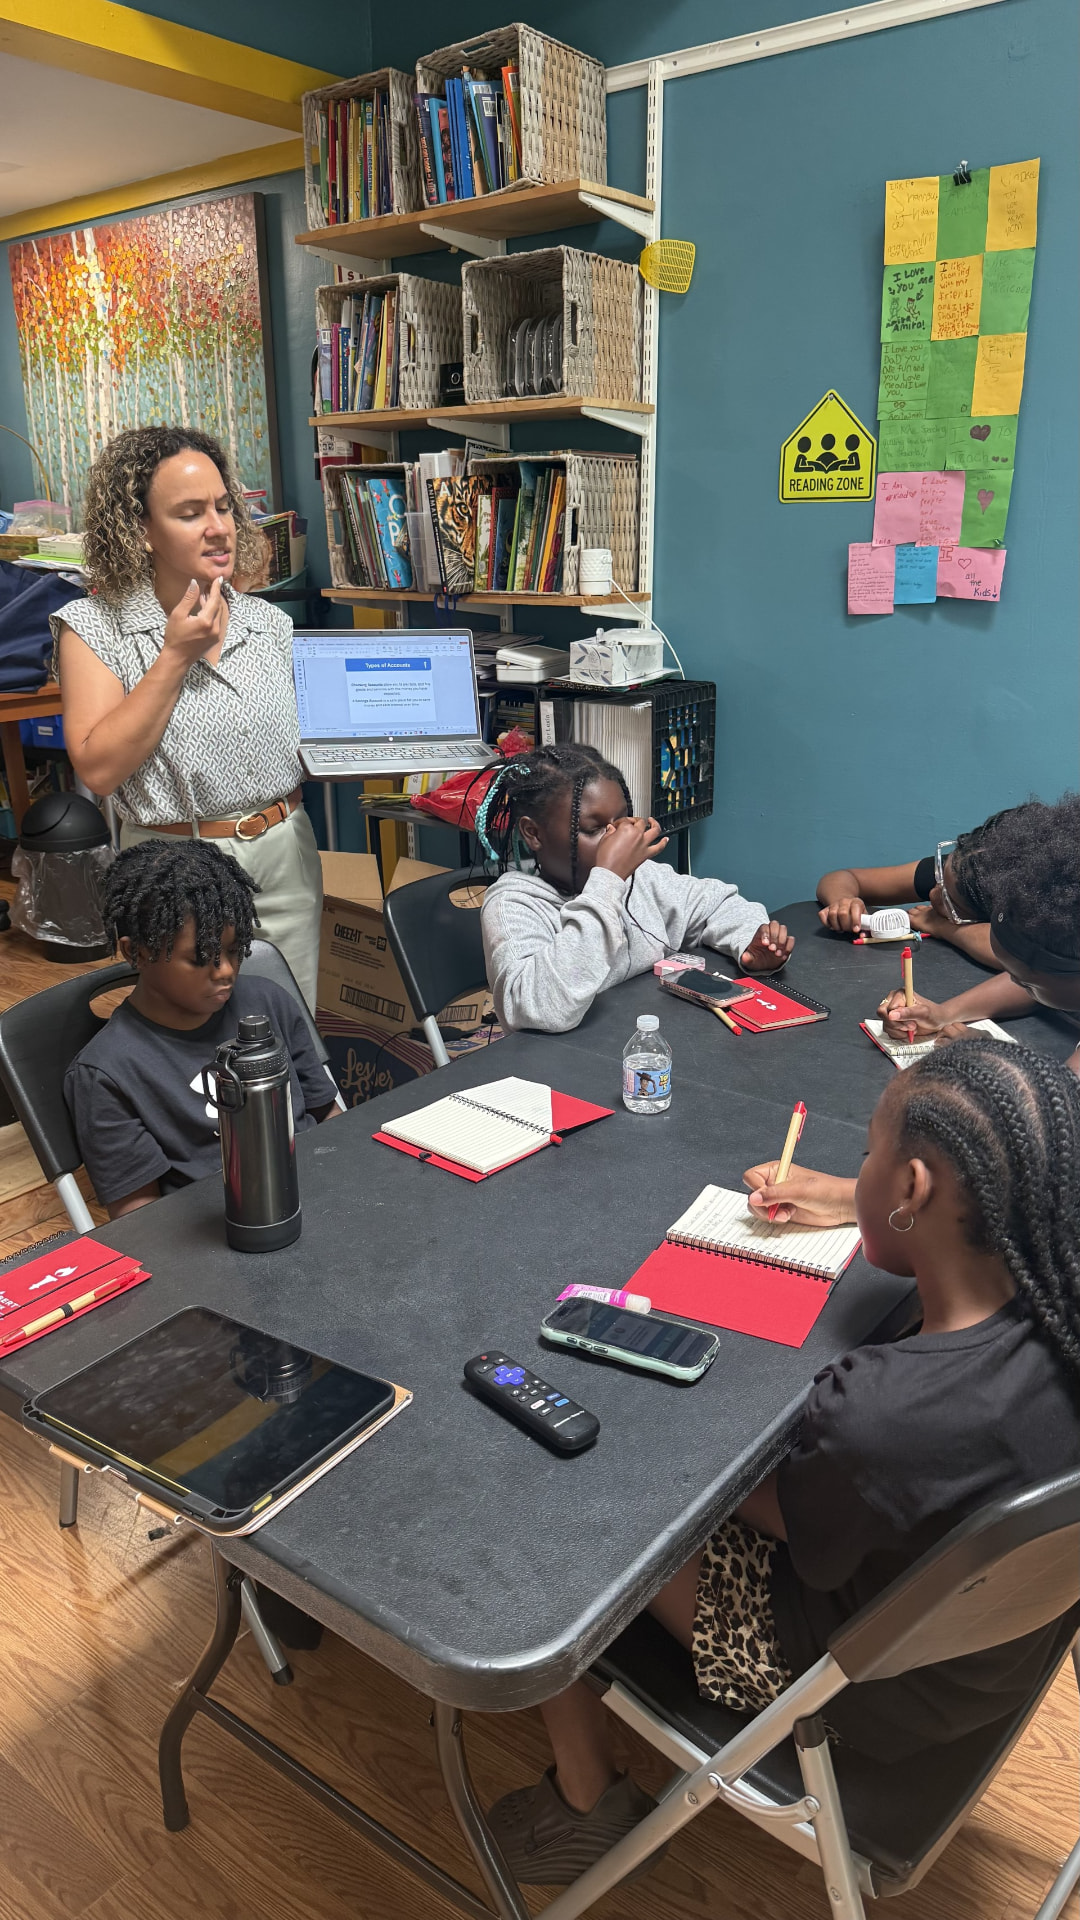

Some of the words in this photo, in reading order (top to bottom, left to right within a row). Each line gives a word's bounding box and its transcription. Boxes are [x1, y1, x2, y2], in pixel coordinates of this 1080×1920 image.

[892, 272, 901, 282] I
[883, 345, 889, 354] I
[789, 478, 834, 492] READING
[836, 477, 864, 491] ZONE
[427, 483, 438, 523] ANIMALS
